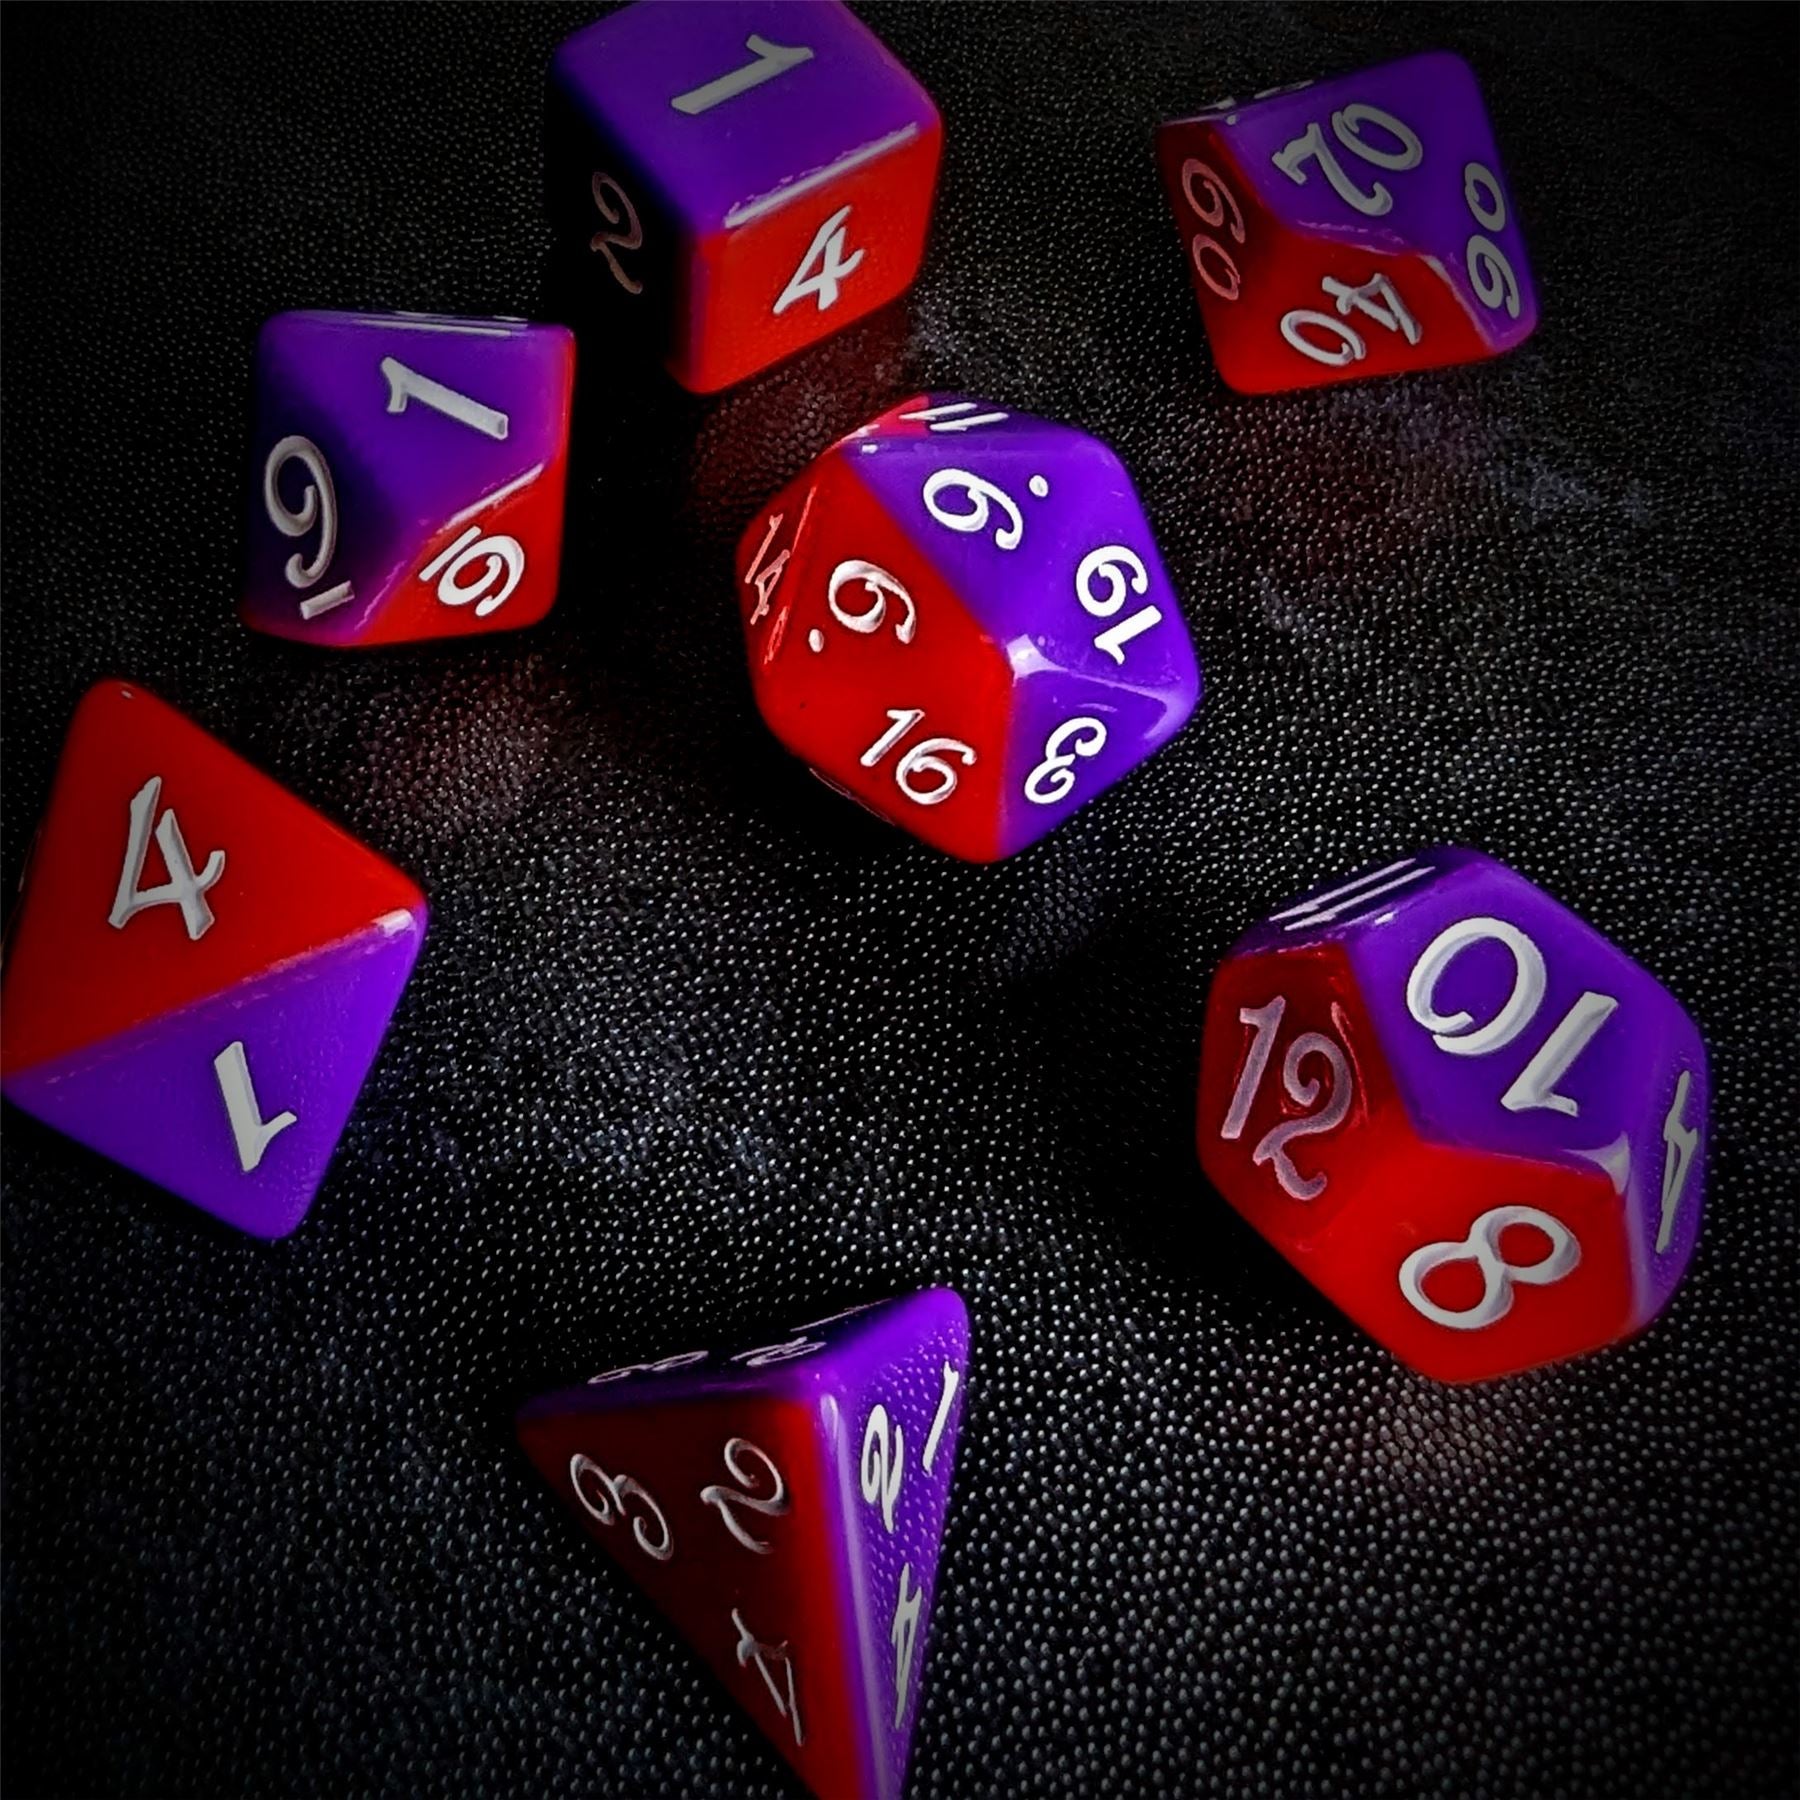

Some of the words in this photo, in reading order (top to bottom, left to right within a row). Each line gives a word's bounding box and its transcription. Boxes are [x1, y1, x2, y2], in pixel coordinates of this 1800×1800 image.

[671, 35, 814, 115] 1
[1272, 104, 1424, 217] 70
[590, 171, 643, 295] 2
[766, 206, 865, 315] 4
[1280, 272, 1423, 366] 40
[380, 356, 509, 440] 1
[1075, 545, 1163, 665] 19
[859, 708, 978, 805] 16
[1024, 716, 1107, 804] 3
[107, 775, 226, 941] 4
[1406, 916, 1620, 1119] 10
[213, 1041, 298, 1173] 1
[1220, 994, 1353, 1202] 12
[1398, 1204, 1582, 1330] 8
[922, 1360, 960, 1476] 1
[569, 1452, 674, 1561] 3
[699, 1437, 791, 1555] 2
[731, 1607, 806, 1747] 4
